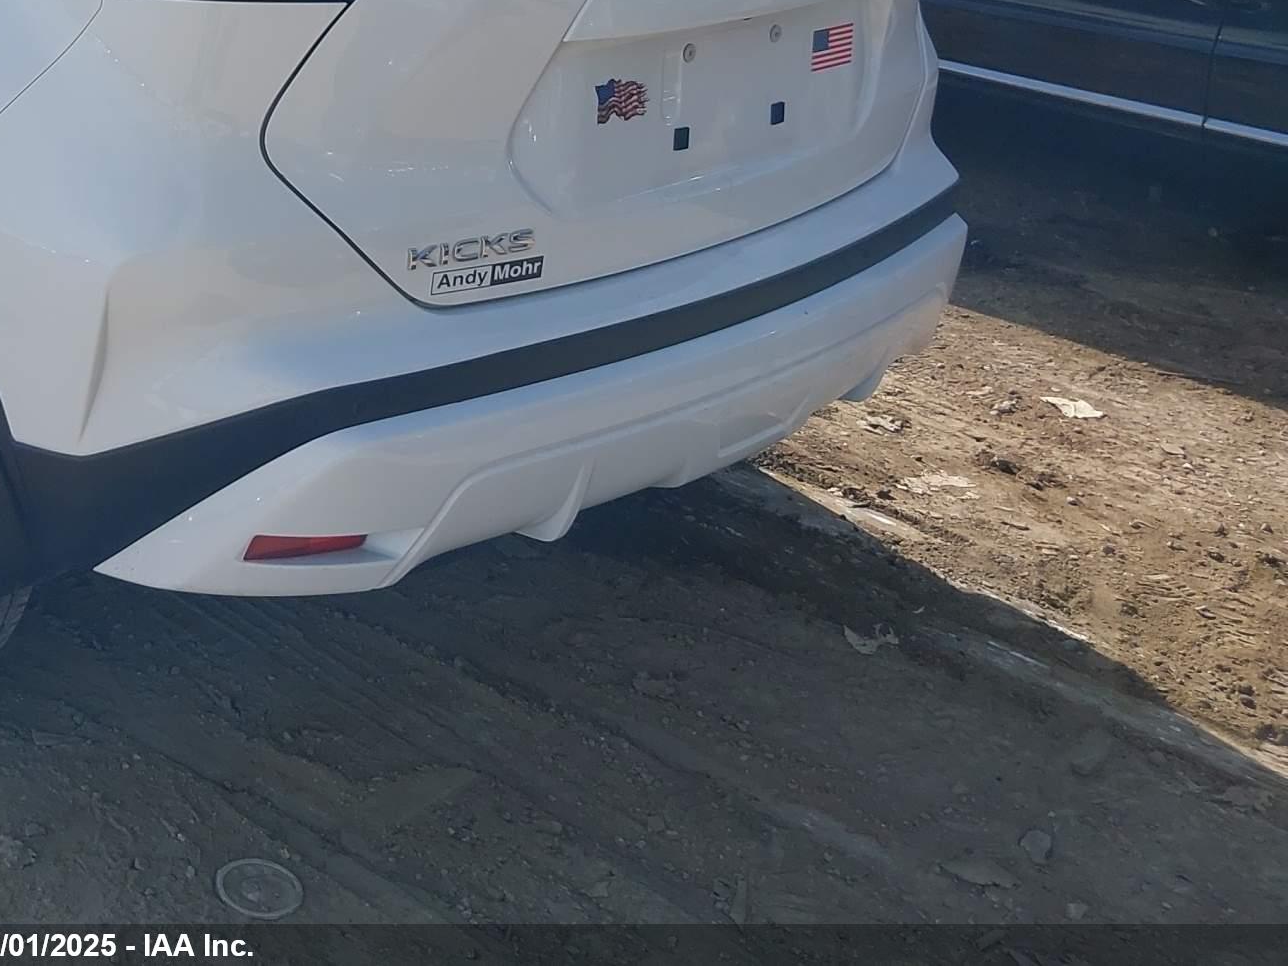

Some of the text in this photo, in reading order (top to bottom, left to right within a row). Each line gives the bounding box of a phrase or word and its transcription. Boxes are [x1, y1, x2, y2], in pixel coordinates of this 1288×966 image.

[407, 229, 535, 270] KICKS
[436, 260, 542, 290] Andy Mohr
